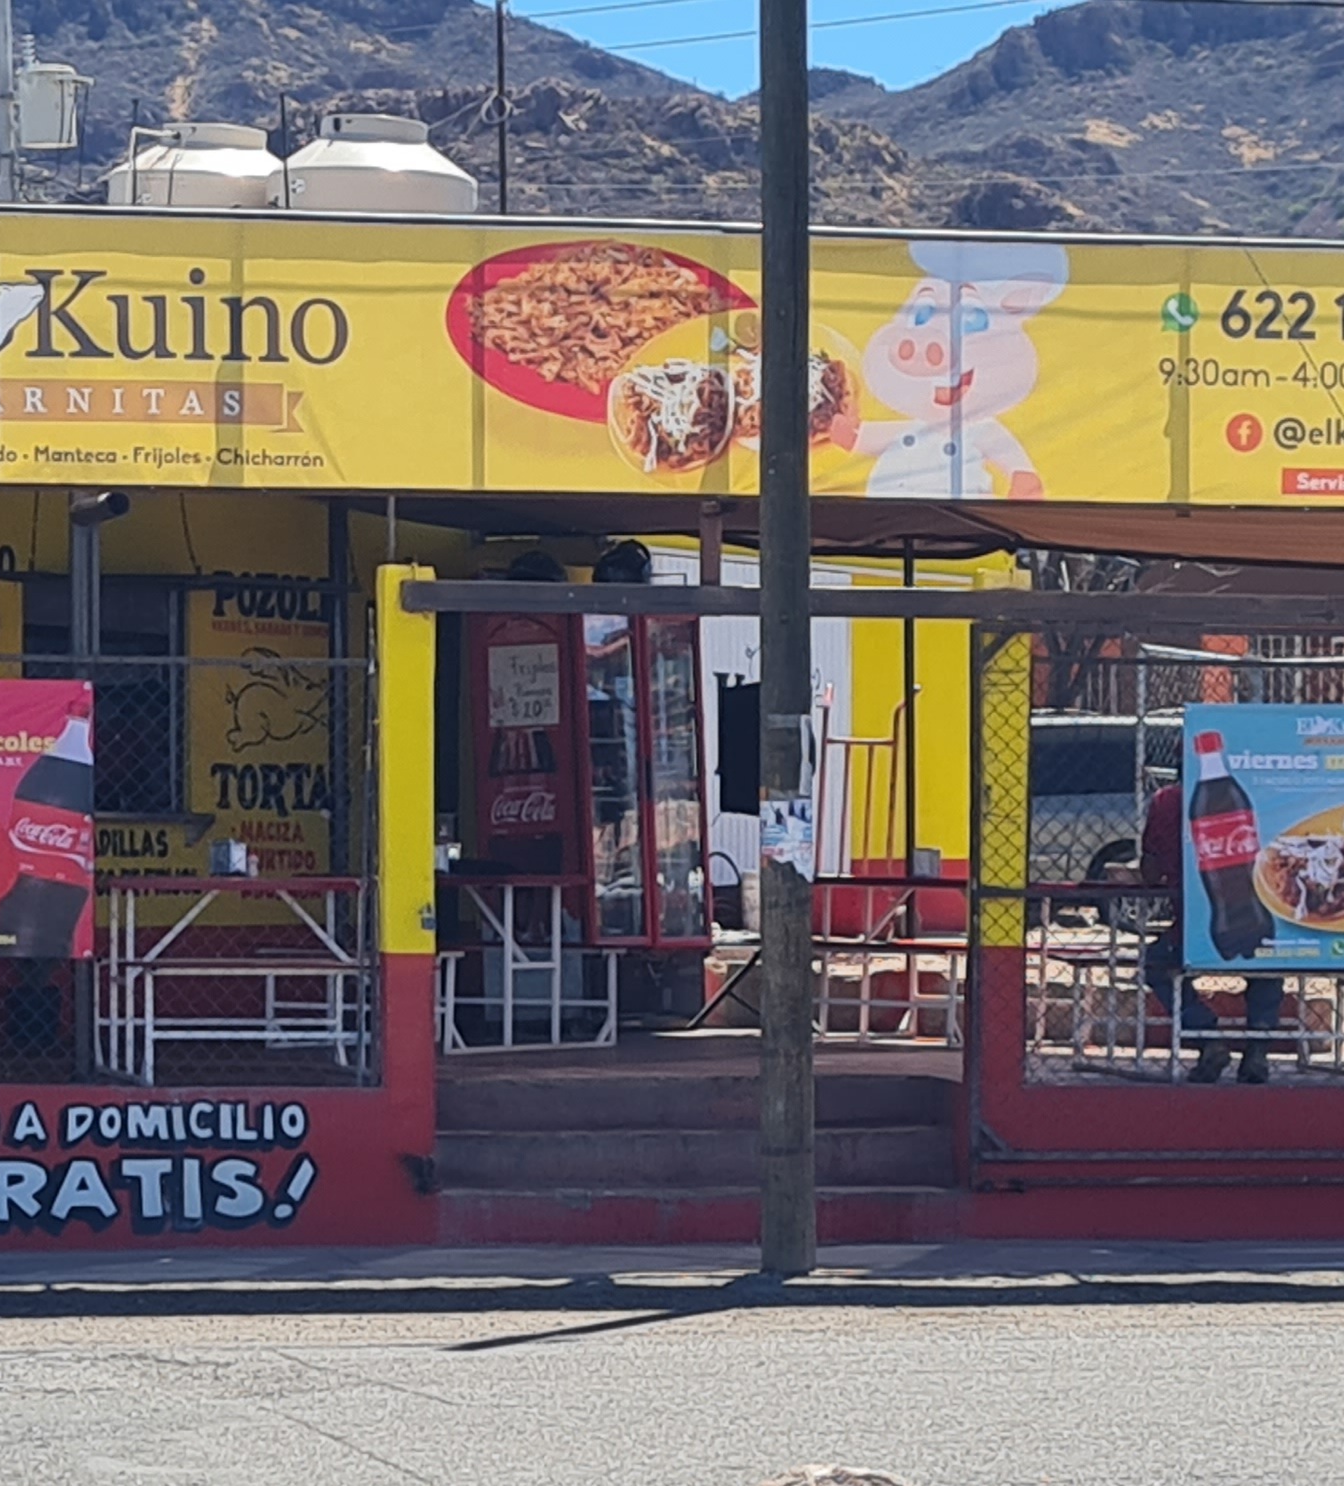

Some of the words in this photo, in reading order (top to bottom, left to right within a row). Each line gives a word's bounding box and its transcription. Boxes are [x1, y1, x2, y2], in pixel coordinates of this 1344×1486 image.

[24, 266, 349, 366] Kuino
[1220, 288, 1317, 341] 622
[33, 445, 118, 464] Manteca
[132, 446, 203, 469] Frijoles
[215, 447, 326, 468] Chicharrón
[1228, 750, 1319, 770] viernes
[12, 1102, 47, 1142] A
[66, 1101, 306, 1142] DOMICILIO
